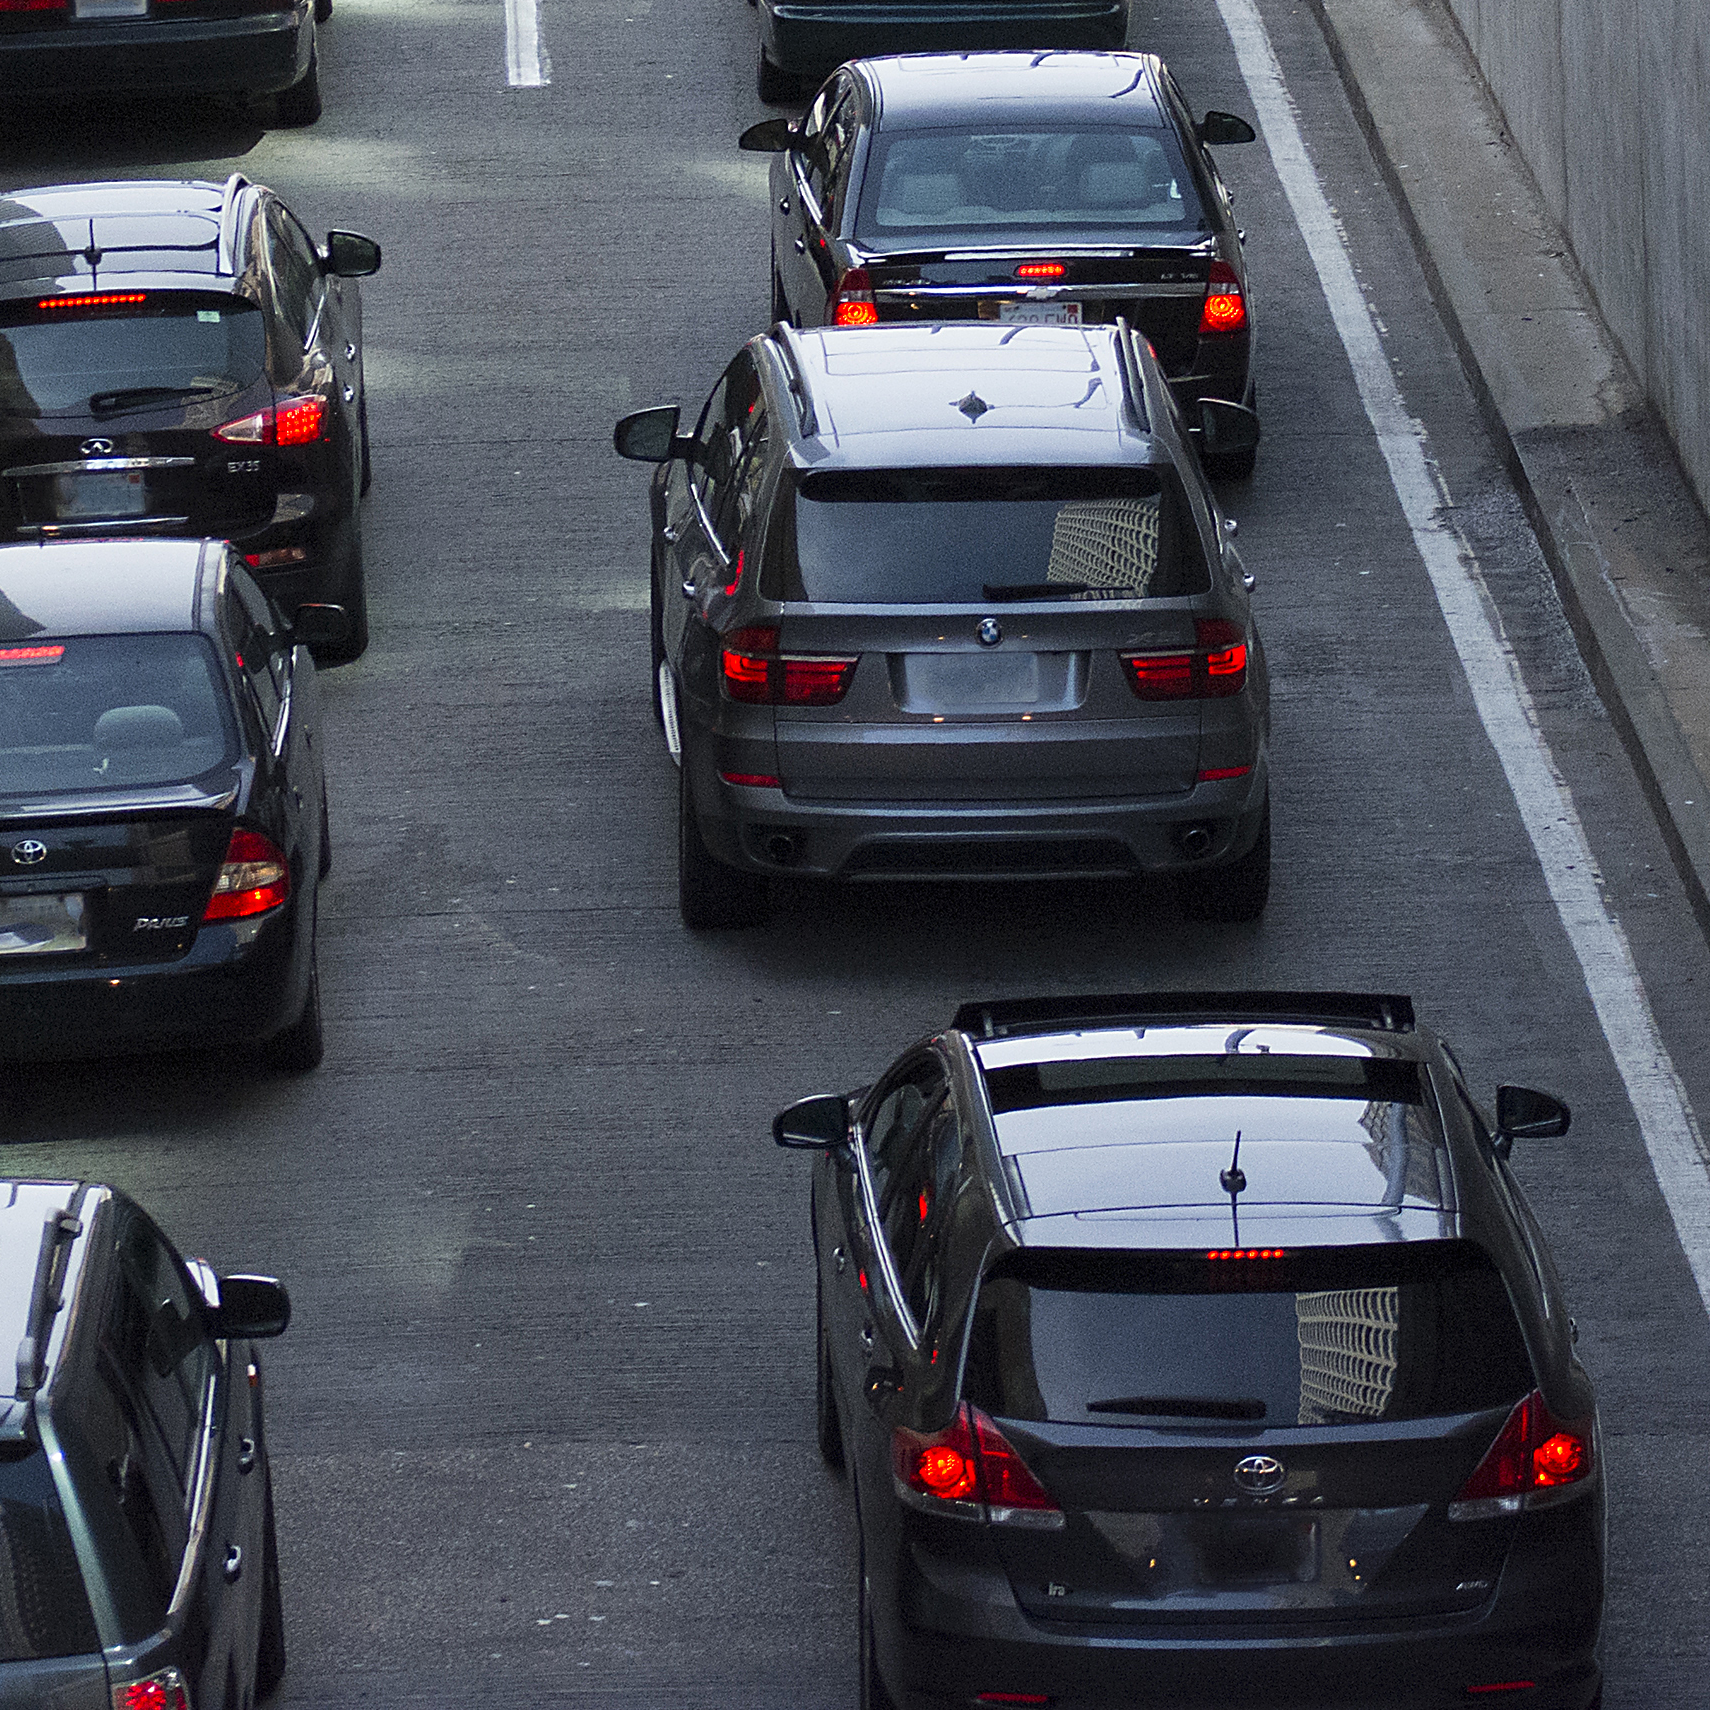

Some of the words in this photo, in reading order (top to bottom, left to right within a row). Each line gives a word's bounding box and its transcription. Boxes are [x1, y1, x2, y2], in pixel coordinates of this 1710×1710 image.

[227, 460, 261, 473] EX35
[133, 916, 189, 931] PRIUS
[1193, 1495, 1324, 1507] VENZA
